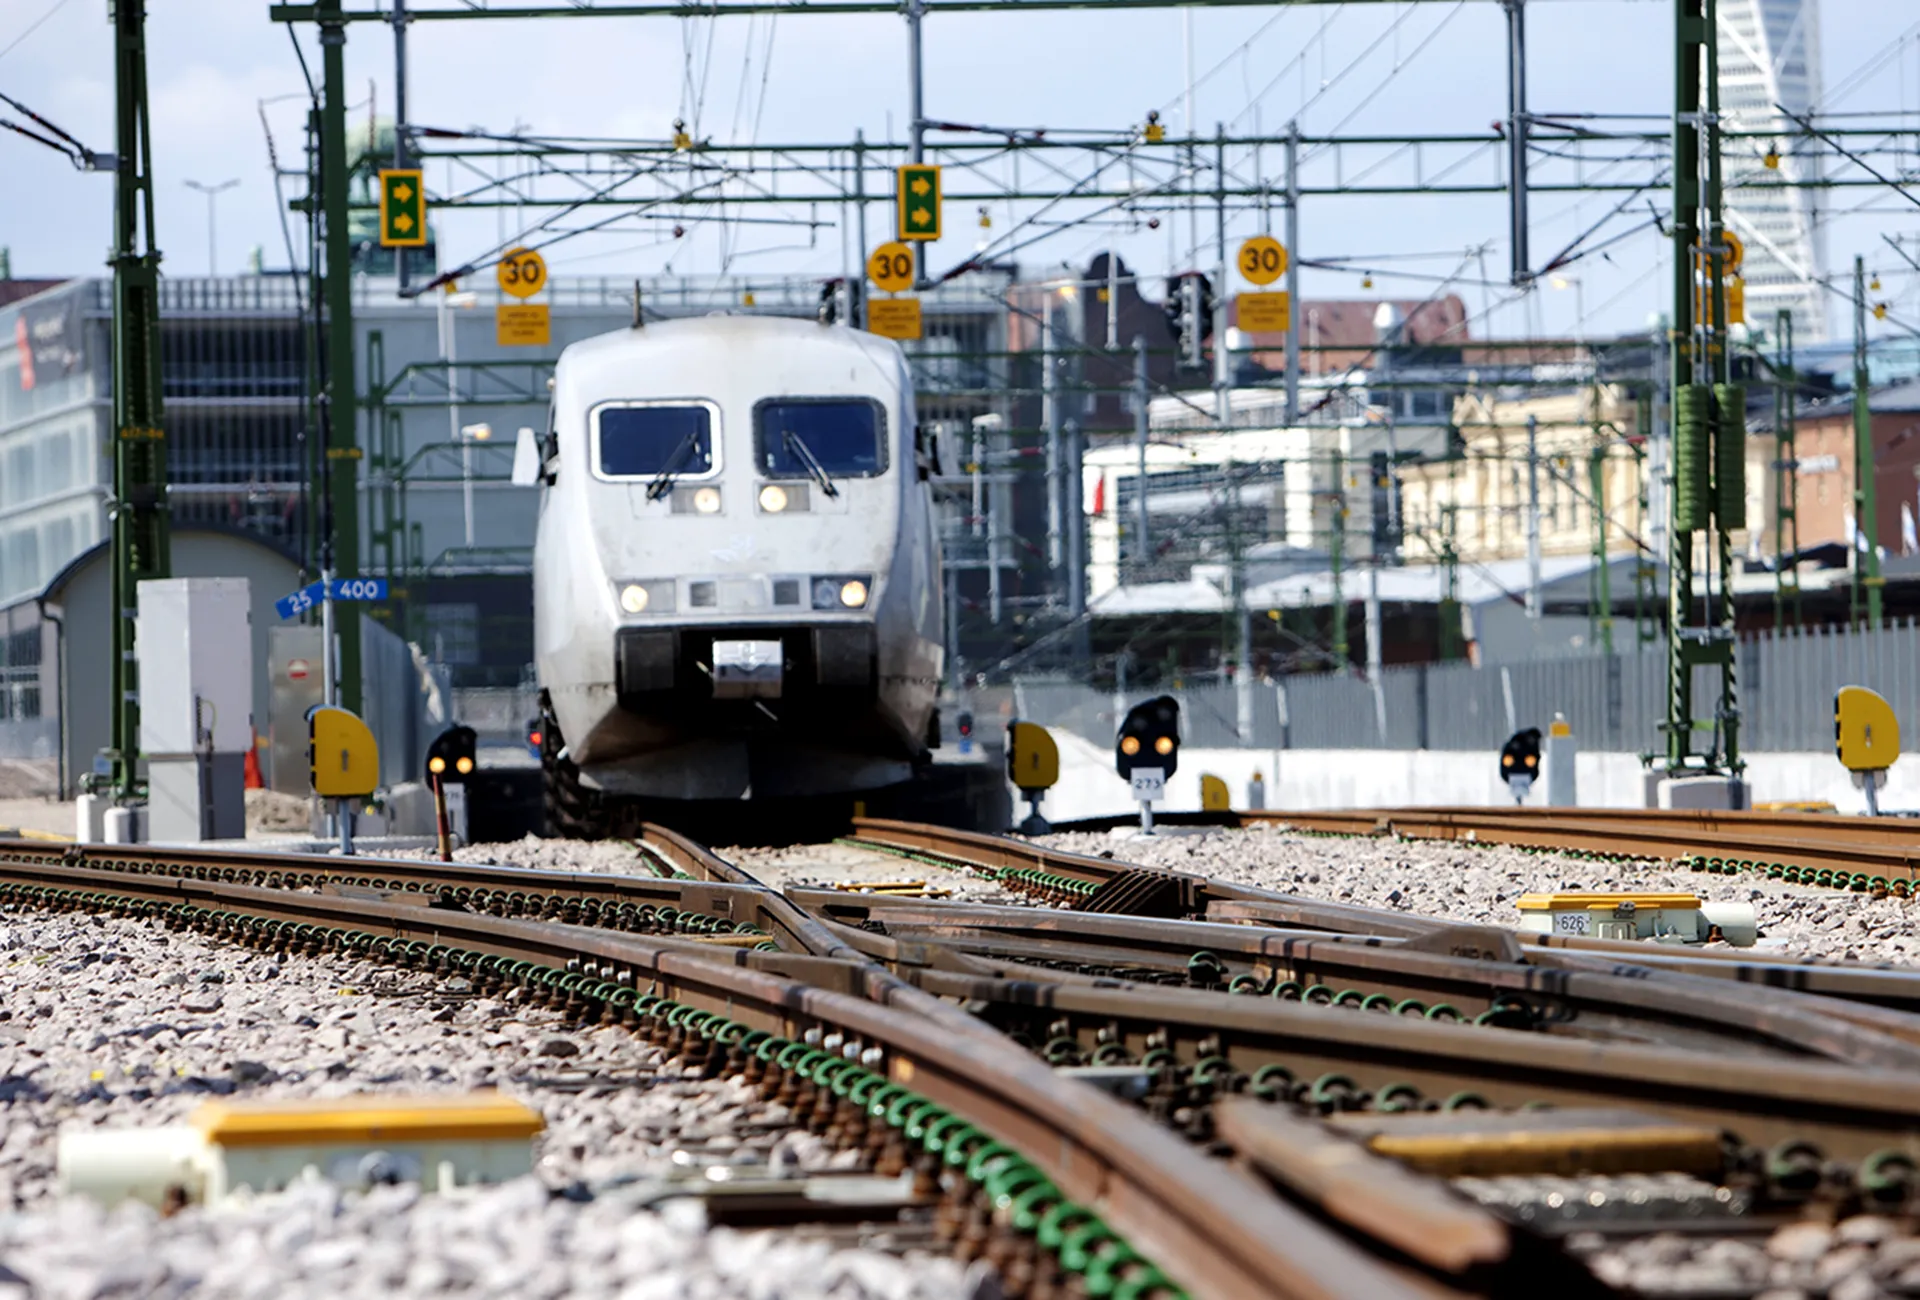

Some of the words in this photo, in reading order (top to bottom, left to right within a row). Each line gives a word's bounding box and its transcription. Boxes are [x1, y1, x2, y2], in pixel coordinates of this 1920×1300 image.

[504, 258, 539, 285] 30
[875, 253, 912, 279] 30
[1245, 247, 1280, 272] 30
[288, 590, 313, 614] 25
[340, 580, 378, 599] 400
[1561, 915, 1585, 930] 626
